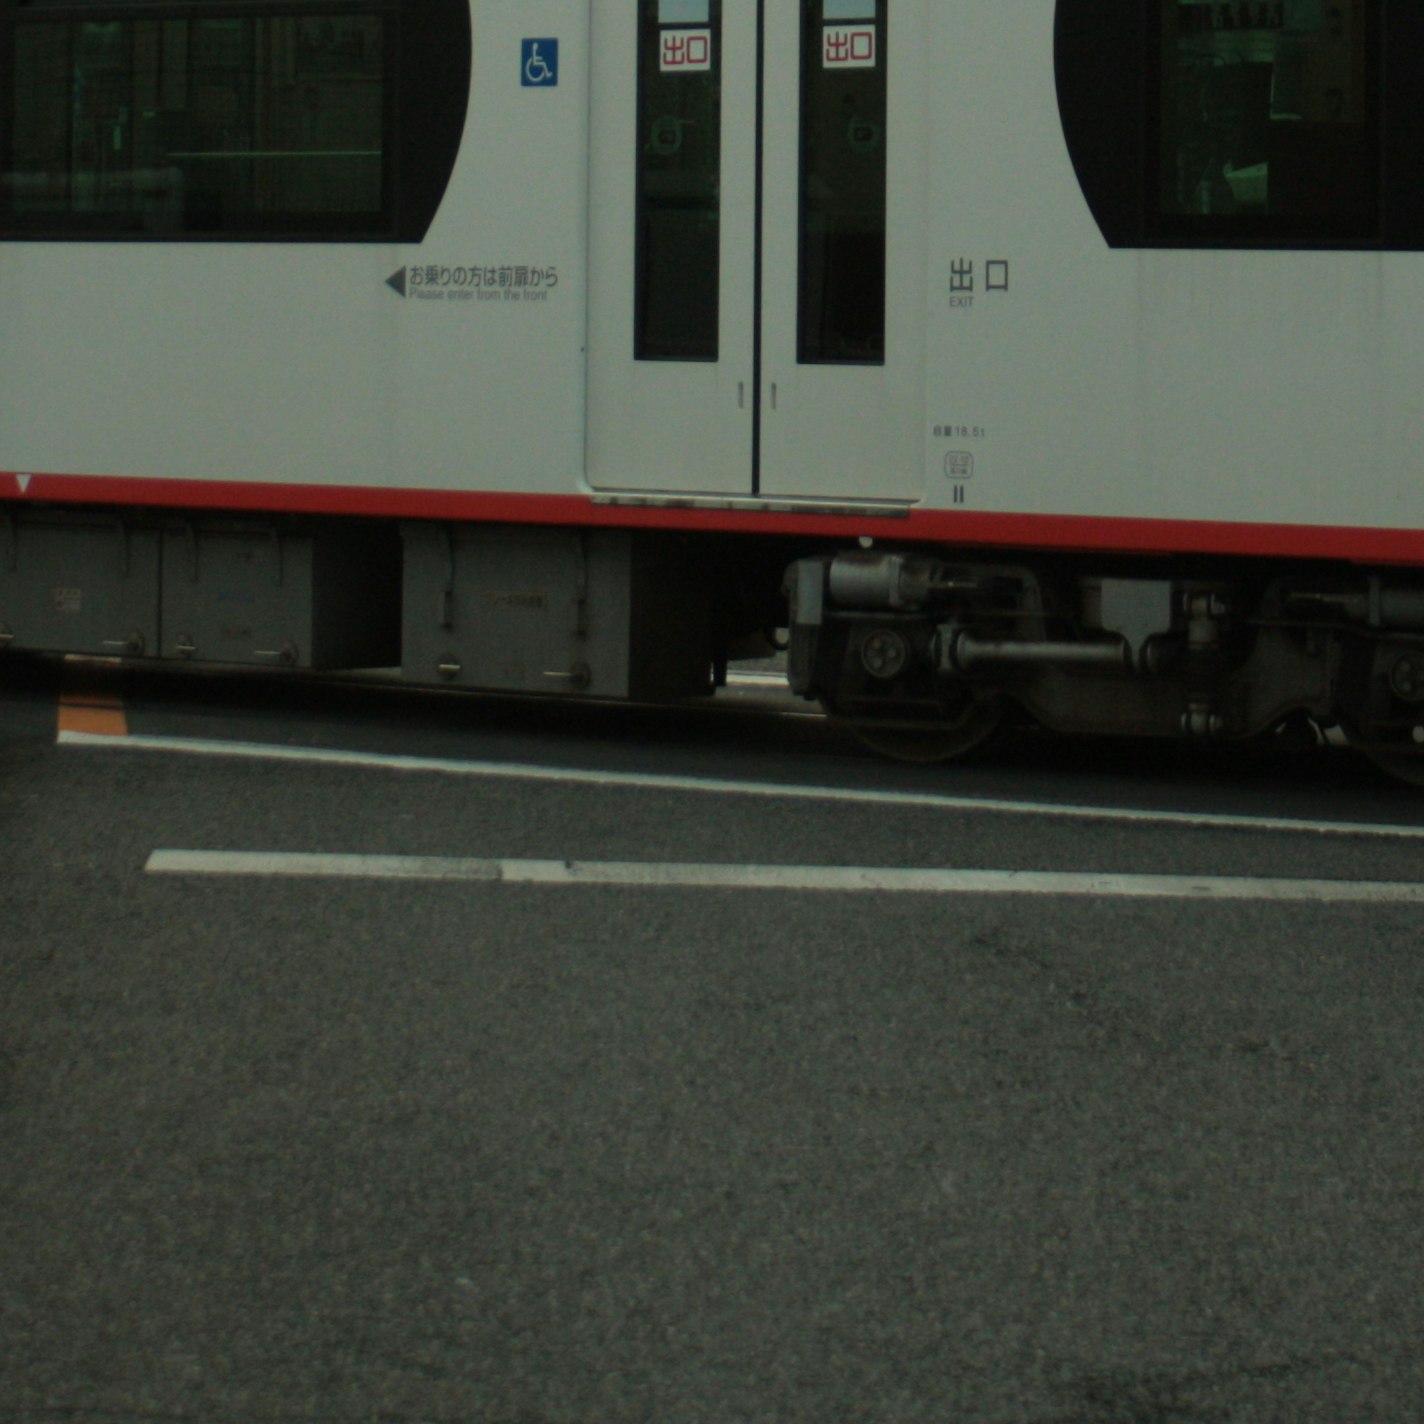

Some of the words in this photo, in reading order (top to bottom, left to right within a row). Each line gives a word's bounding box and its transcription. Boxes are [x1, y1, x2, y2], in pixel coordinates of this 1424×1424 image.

[663, 35, 708, 65] 出口
[826, 31, 872, 62] 出口
[409, 265, 559, 288] お乗りの方は前扉から
[949, 257, 1009, 292] 出口
[409, 289, 444, 300] Please
[447, 290, 474, 301] enter
[477, 289, 501, 300] from
[504, 289, 520, 301] the
[525, 289, 548, 301] front
[949, 296, 974, 308] EXIT
